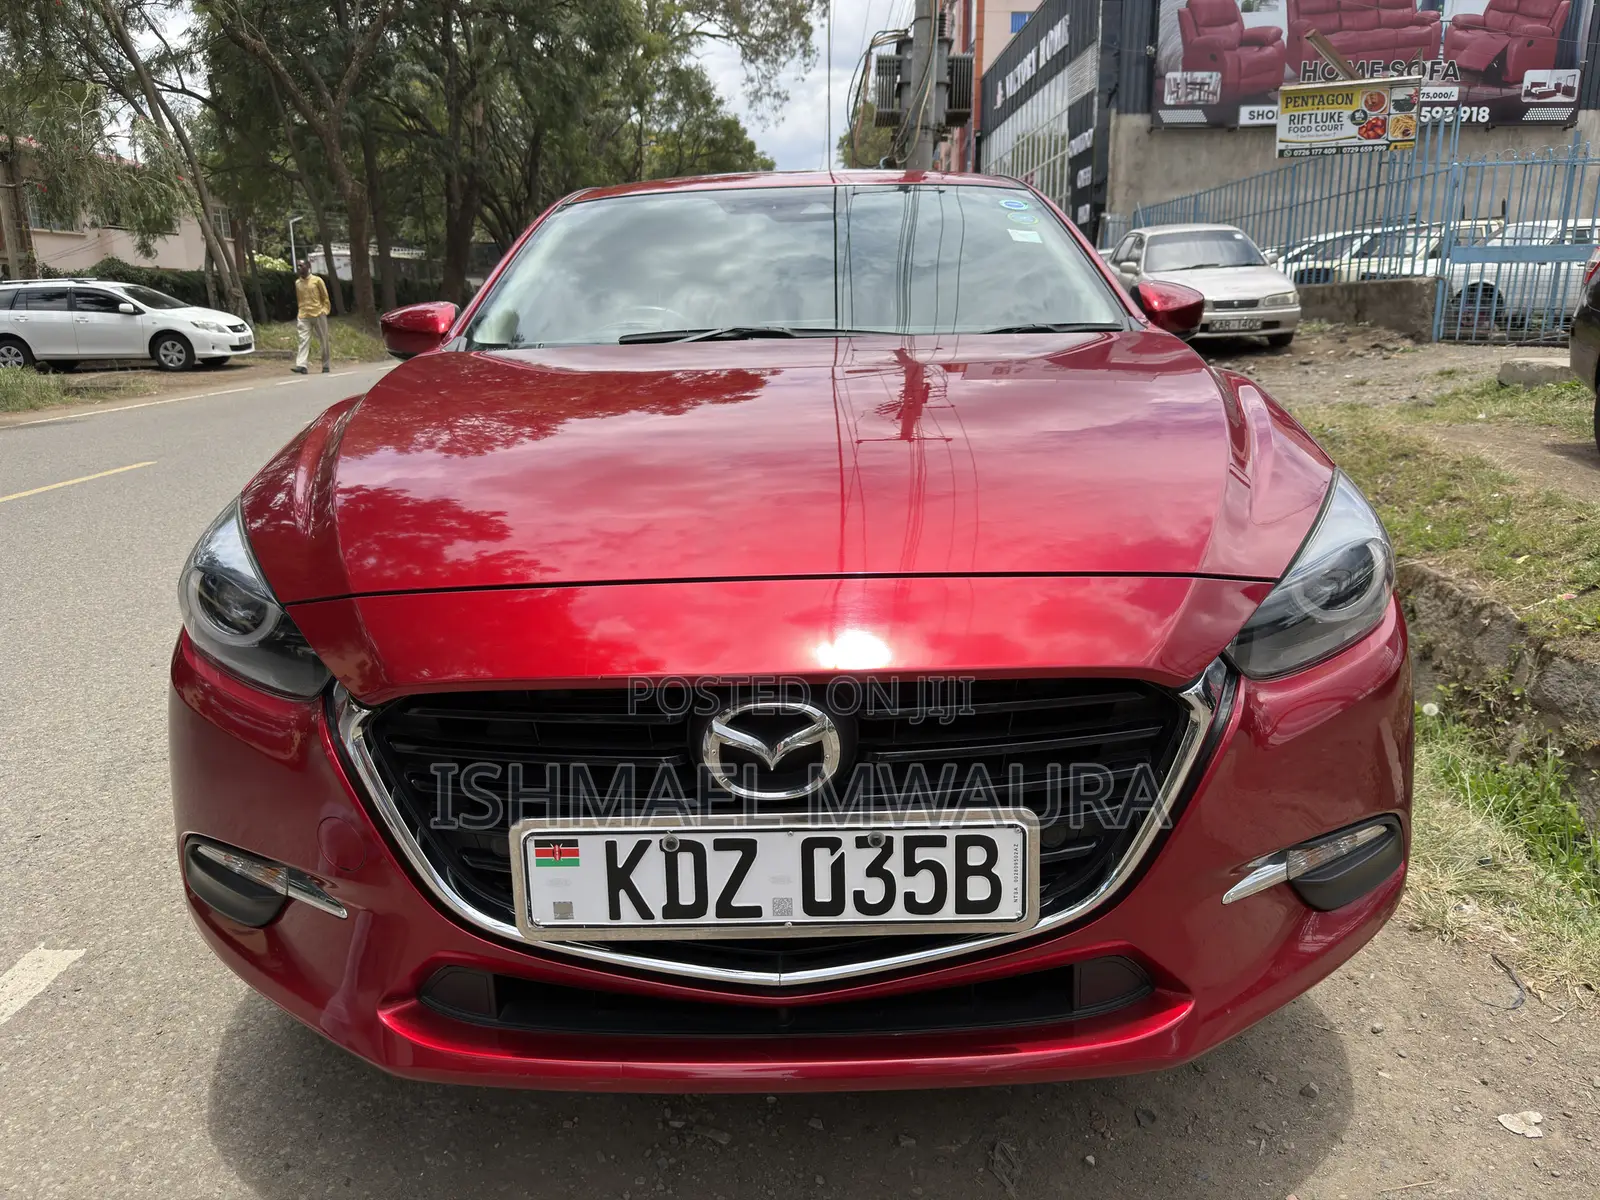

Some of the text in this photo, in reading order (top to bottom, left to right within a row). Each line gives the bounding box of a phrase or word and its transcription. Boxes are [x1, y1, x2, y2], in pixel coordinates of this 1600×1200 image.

[1389, 59, 1460, 82] SOFA
[1284, 93, 1354, 109] PENTAGON
[1288, 111, 1344, 126] RIFTLUKE
[1460, 106, 1490, 123] 918
[1287, 124, 1344, 134] FOOD COURT
[1293, 148, 1310, 156] 0726
[606, 833, 1003, 921] KDZ 035B
